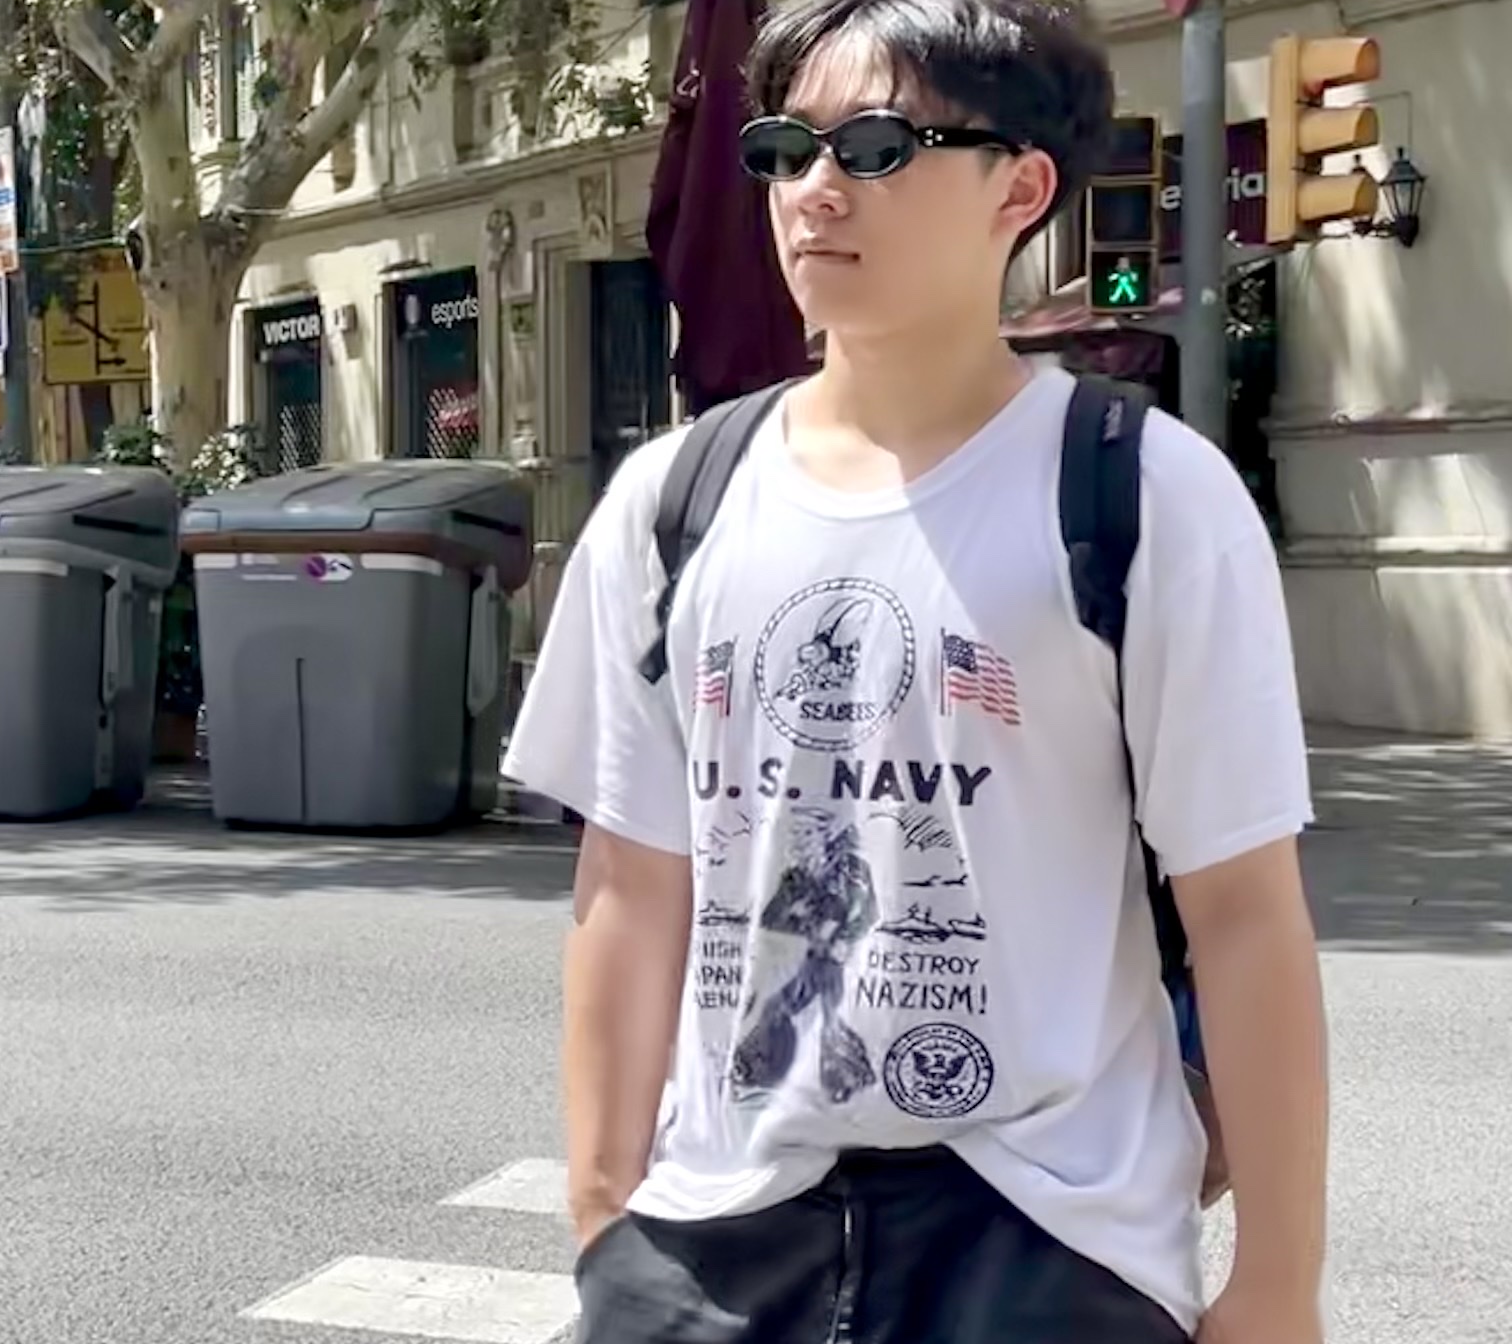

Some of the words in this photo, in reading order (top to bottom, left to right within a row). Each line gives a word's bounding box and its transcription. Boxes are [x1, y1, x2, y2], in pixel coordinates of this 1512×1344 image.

[431, 295, 479, 329] esports
[263, 314, 321, 345] VICTOR
[799, 701, 877, 722] SEABEES
[831, 759, 992, 806] NAVY
[869, 951, 980, 975] DESTROY
[856, 977, 987, 1015] NAZISM!
